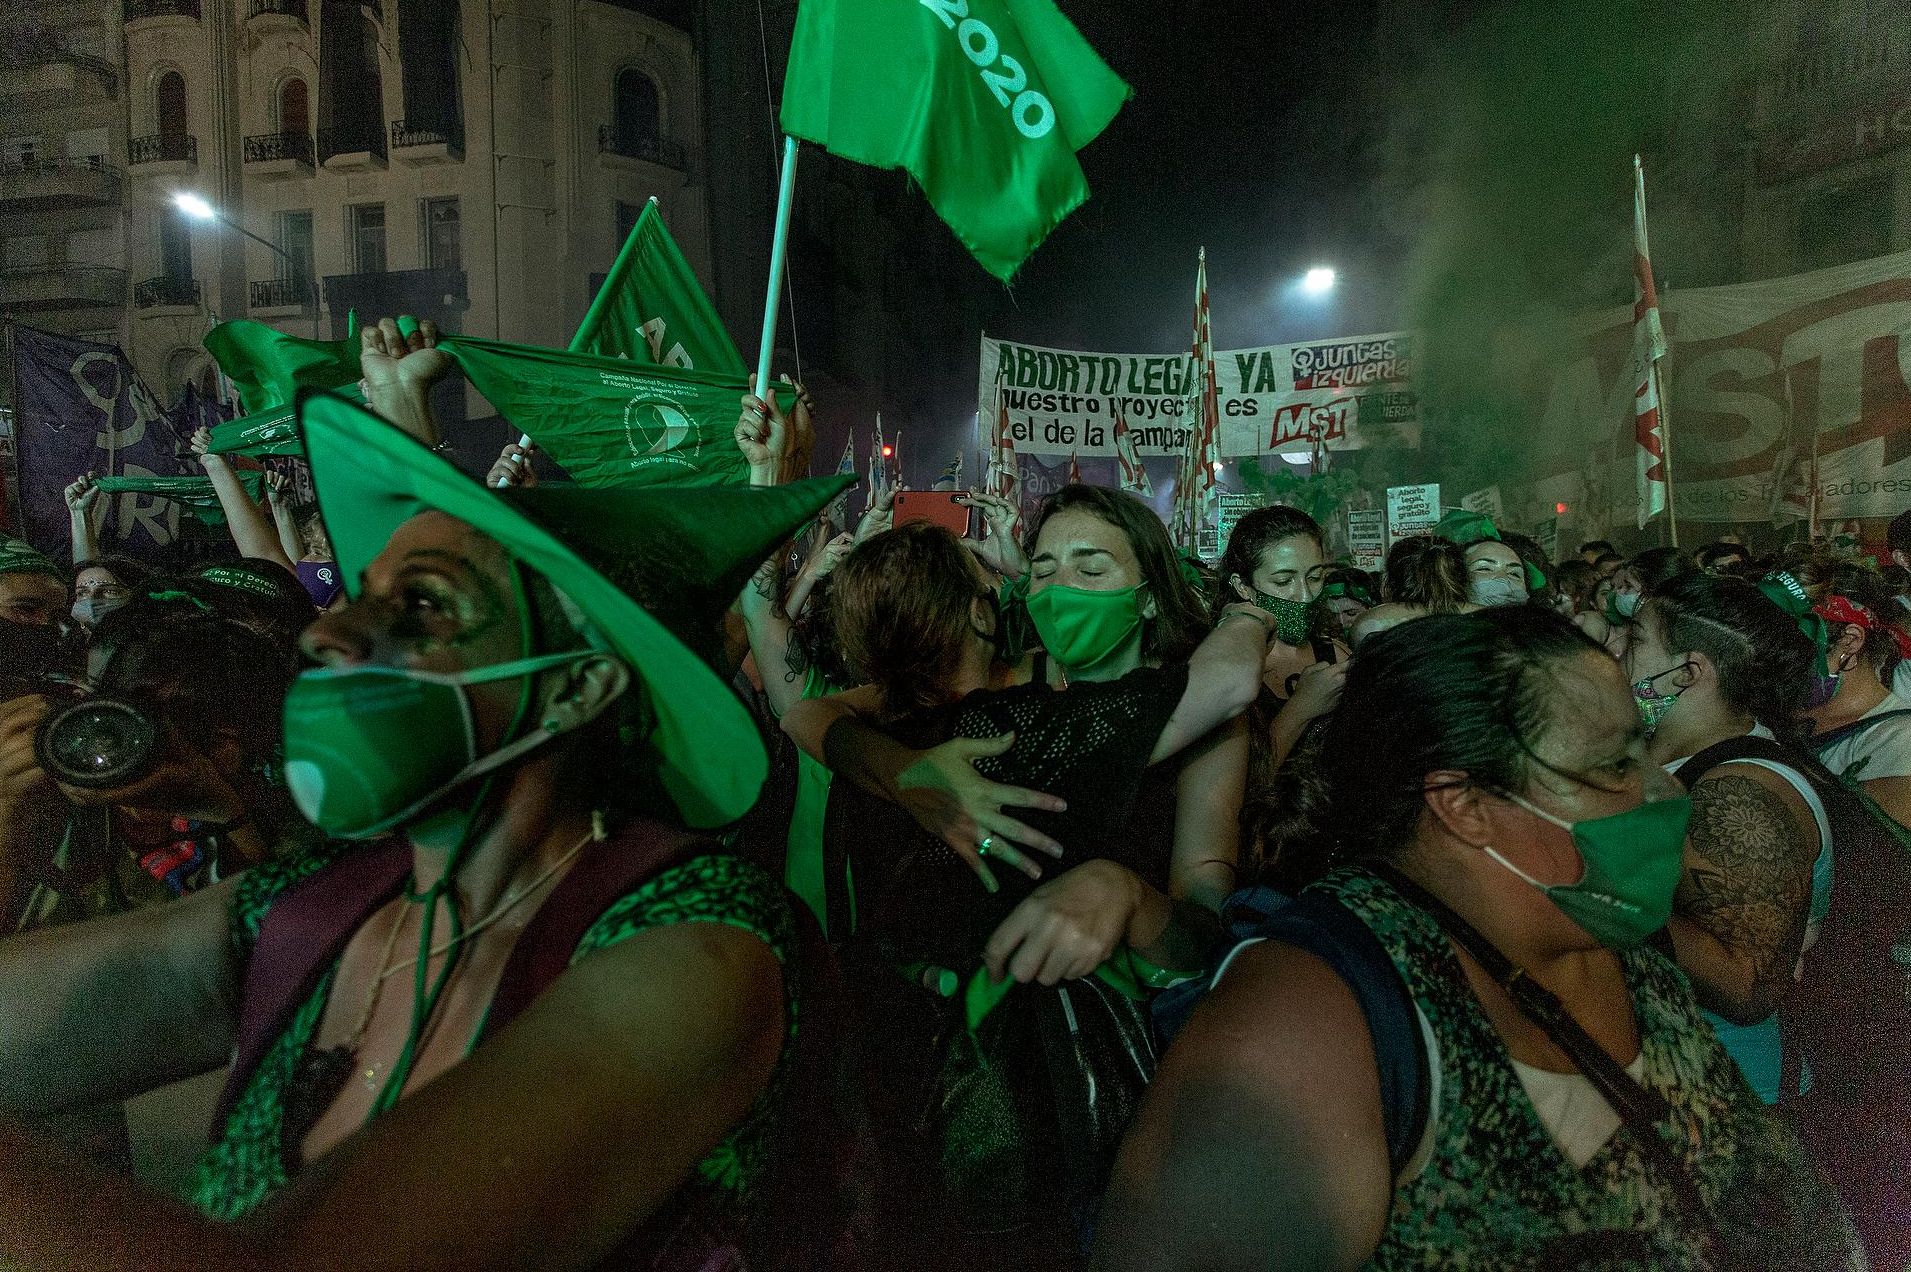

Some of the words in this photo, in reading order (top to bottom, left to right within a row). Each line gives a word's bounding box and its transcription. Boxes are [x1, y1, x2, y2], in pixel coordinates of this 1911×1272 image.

[920, 0, 1056, 139] 2020
[994, 342, 1123, 396] ABORTO
[1126, 355, 1224, 396] LEG
[1235, 351, 1277, 394] YA
[1225, 399, 1259, 417] es
[1276, 402, 1349, 442] MST
[1011, 416, 1034, 441] el
[1044, 418, 1075, 445] de
[1084, 418, 1105, 447] la
[1397, 503, 1424, 511] seguro
